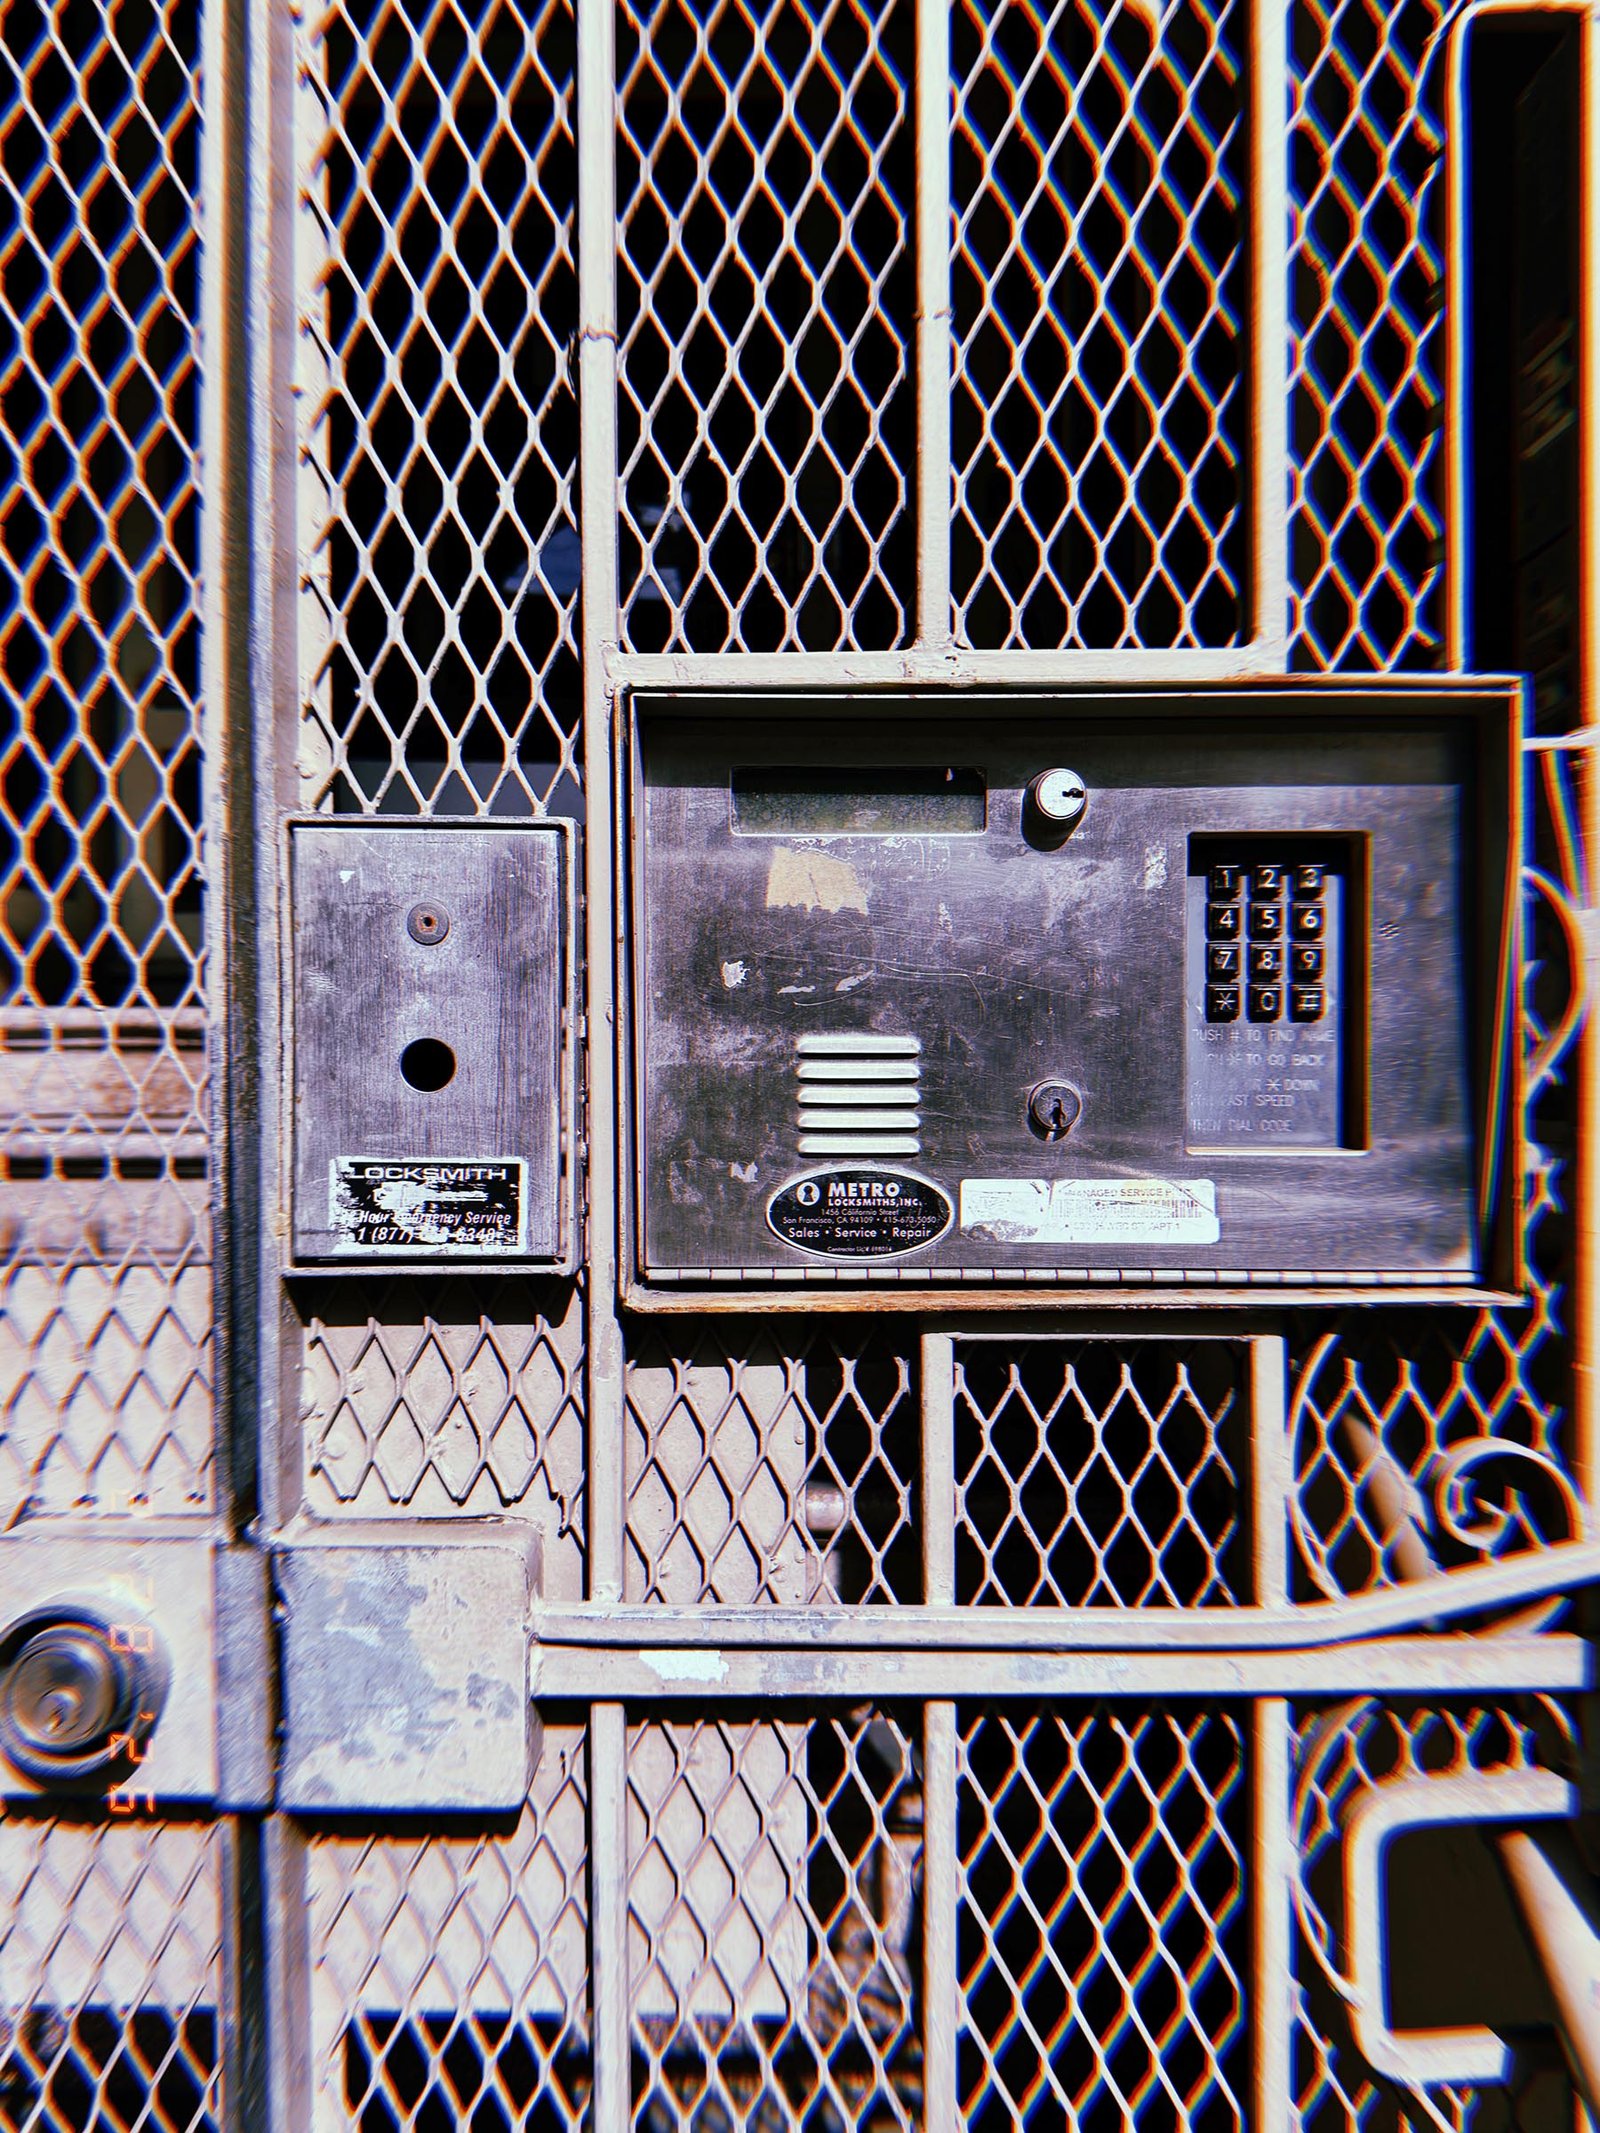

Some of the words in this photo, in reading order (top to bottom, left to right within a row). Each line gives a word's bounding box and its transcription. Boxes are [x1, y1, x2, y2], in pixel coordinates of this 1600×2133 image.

[1221, 869, 1230, 888] 1
[1260, 868, 1276, 888] 2
[1302, 868, 1319, 888] 3
[1219, 909, 1234, 928] 4
[1261, 909, 1276, 929] 5
[1302, 909, 1319, 928] 6
[1218, 950, 1232, 969] 7
[1261, 950, 1275, 969] 8
[1303, 950, 1317, 969] 9
[1245, 1029, 1262, 1042] TO
[827, 1182, 901, 1198] METRO
[465, 1211, 512, 1225] Service
[820, 1208, 840, 1216] 1456
[841, 1207, 878, 1216] California
[878, 1207, 900, 1216] Street
[782, 1216, 798, 1225] San
[799, 1216, 835, 1225] Francisco,
[836, 1216, 848, 1224] CA
[849, 1216, 874, 1224] 94109
[357, 1227, 365, 1241] 1
[788, 1226, 820, 1239] Sales
[834, 1226, 878, 1239] Service
[891, 1226, 933, 1240] Repair
